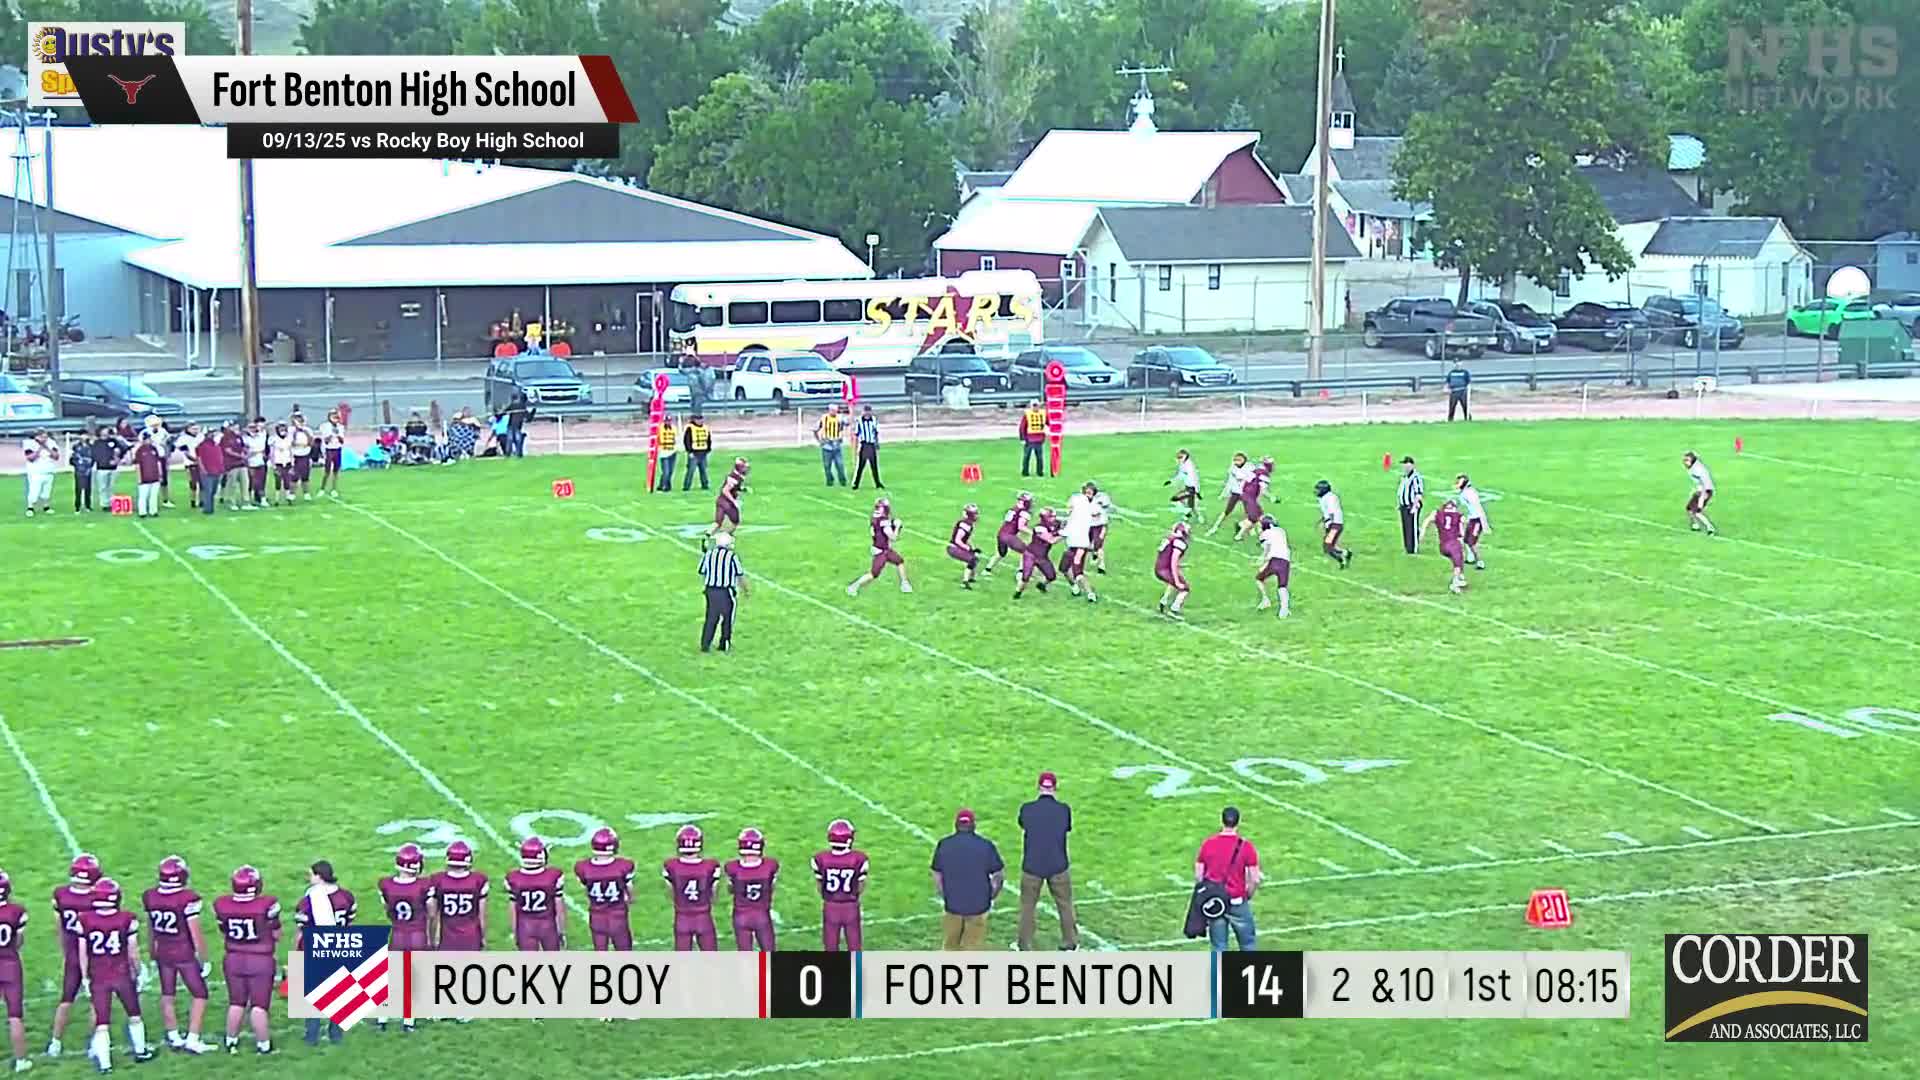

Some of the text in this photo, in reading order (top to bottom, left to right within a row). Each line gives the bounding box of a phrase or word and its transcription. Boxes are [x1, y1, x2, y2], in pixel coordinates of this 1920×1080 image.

[866, 293, 1033, 338] STARS
[1111, 758, 1328, 798] 20
[376, 809, 607, 857] 30
[588, 881, 620, 902] 44
[684, 880, 698, 900] 4
[826, 869, 855, 892] 57
[521, 890, 548, 912] 12
[747, 885, 762, 900] 5
[443, 893, 474, 915] 55
[1541, 895, 1568, 921] 20
[151, 911, 178, 933] 22
[228, 918, 257, 940] 51
[88, 931, 121, 955] 24
